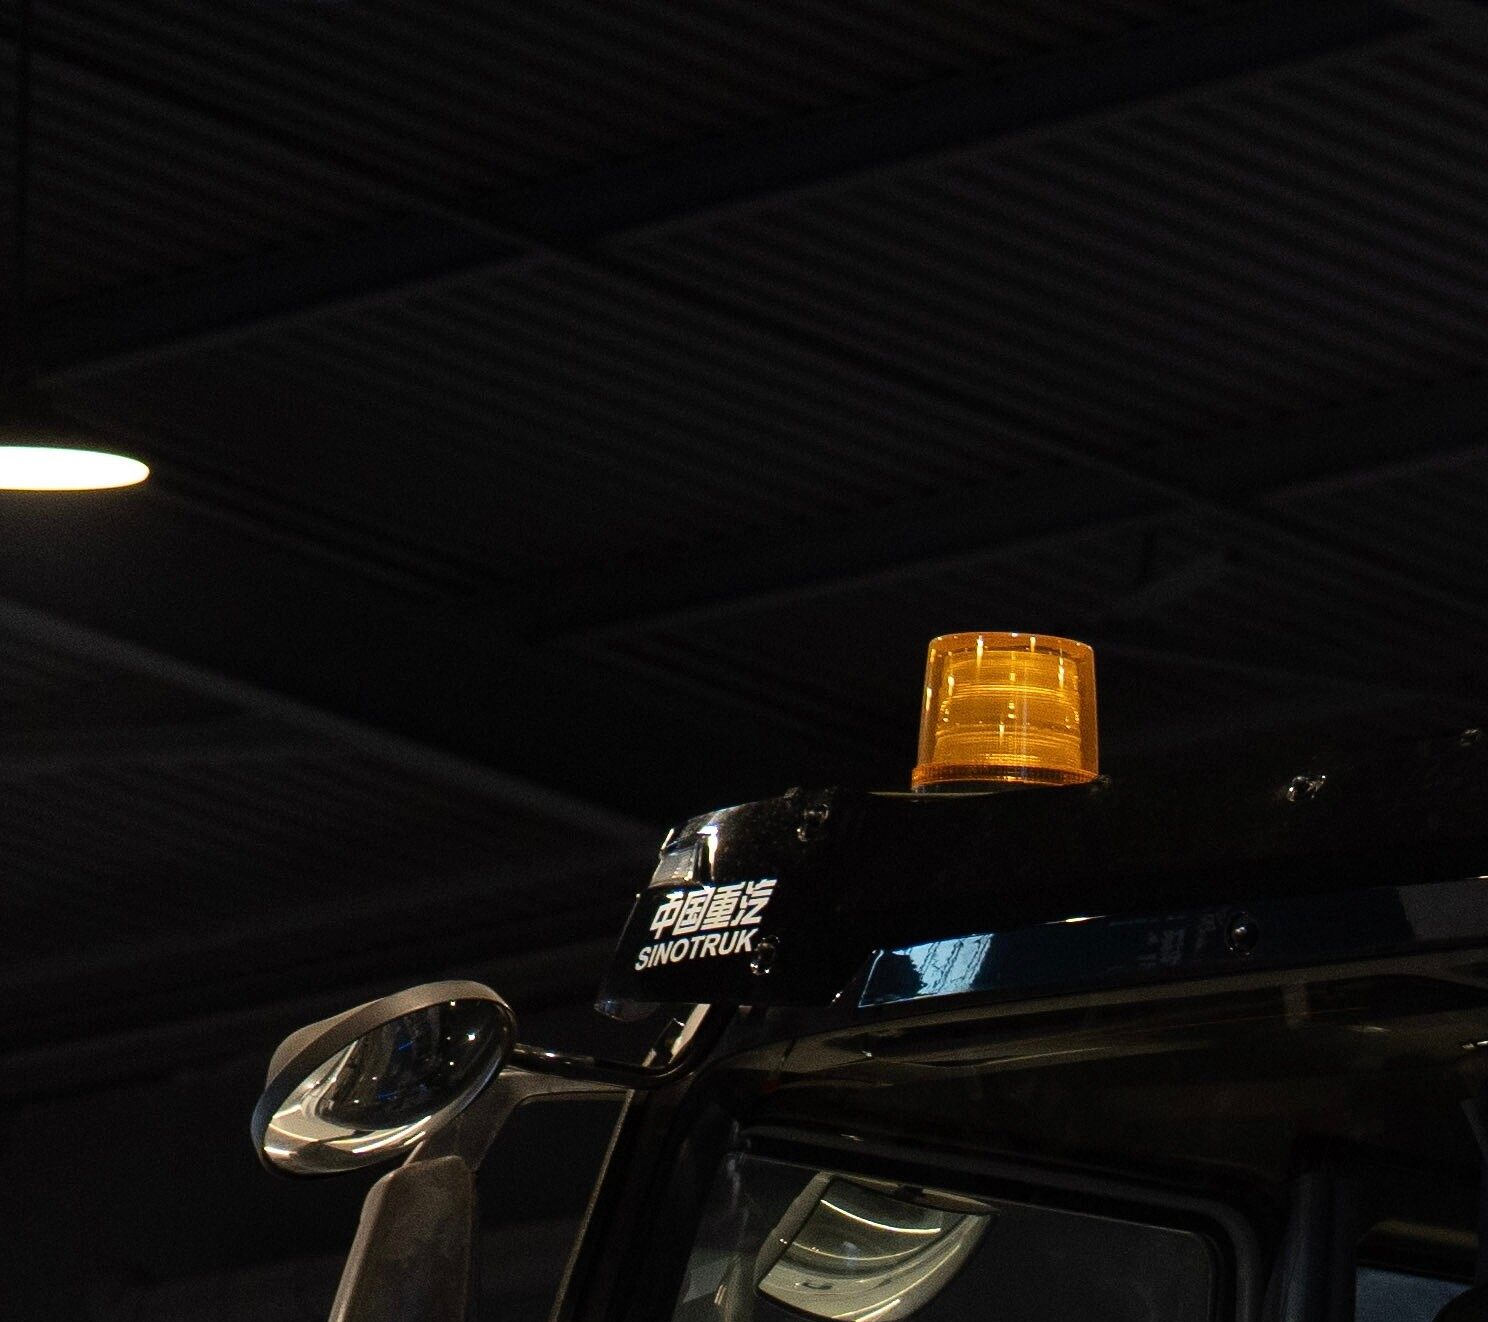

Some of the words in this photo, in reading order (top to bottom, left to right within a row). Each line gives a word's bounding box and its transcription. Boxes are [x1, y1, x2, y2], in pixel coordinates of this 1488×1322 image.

[650, 878, 778, 940] 中国重汽
[634, 927, 759, 971] SINOTRUK
